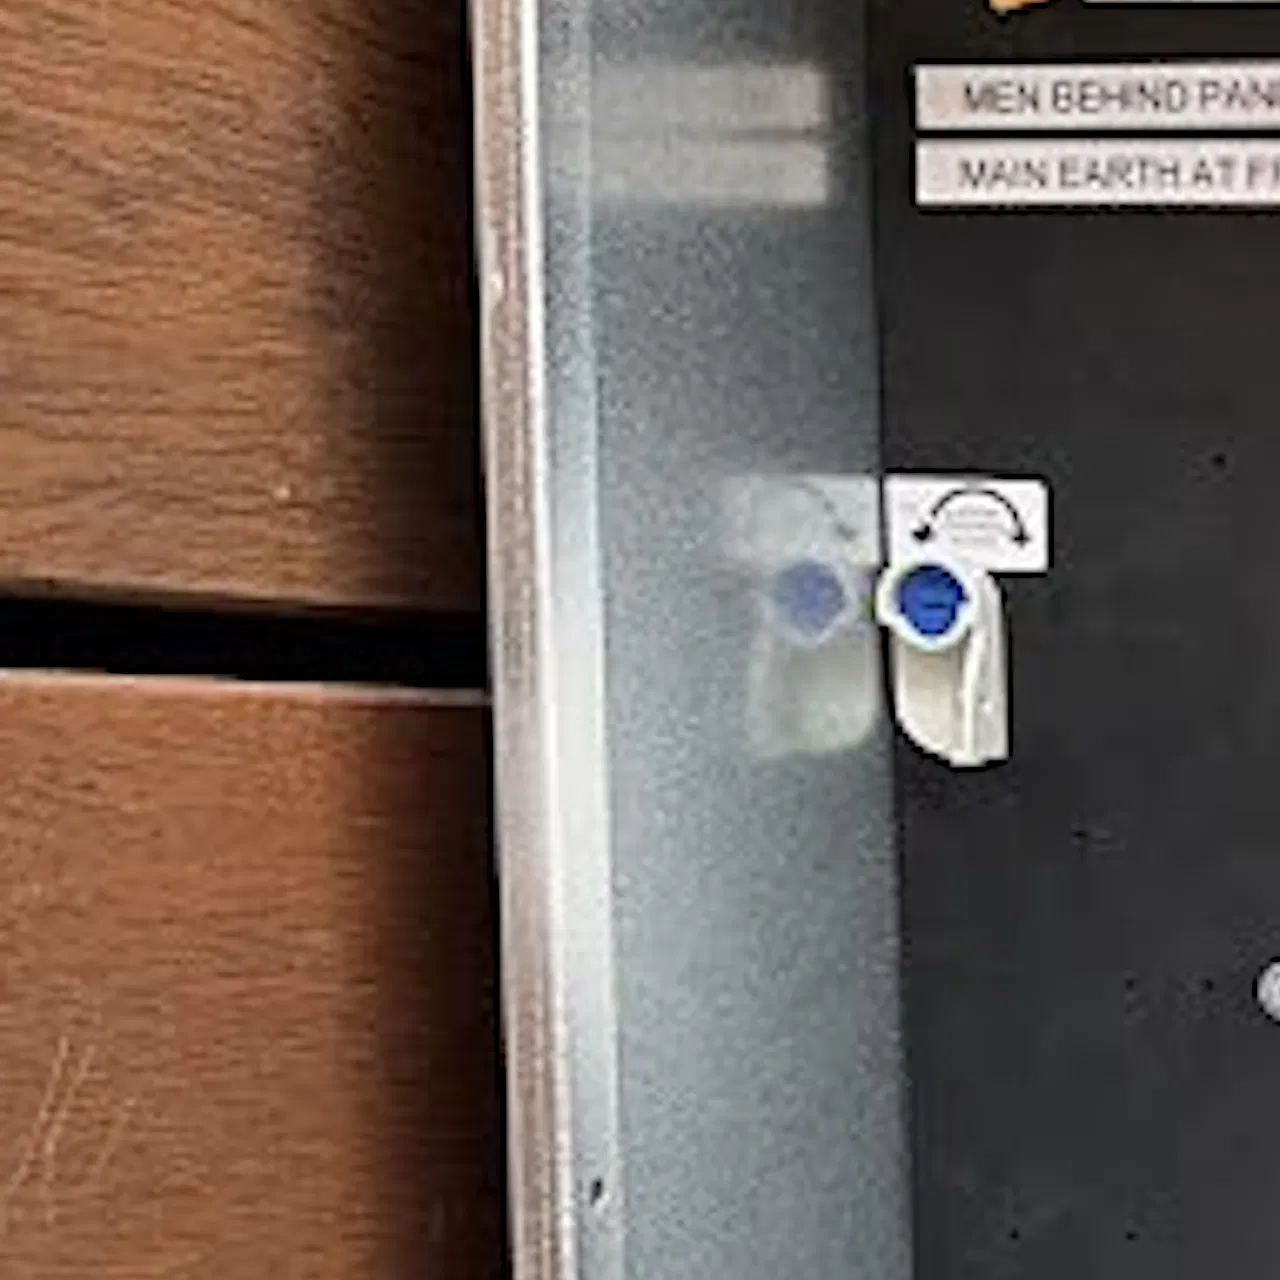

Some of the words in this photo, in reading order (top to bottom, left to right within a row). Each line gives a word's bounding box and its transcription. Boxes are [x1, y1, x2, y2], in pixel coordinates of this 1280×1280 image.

[1052, 79, 1188, 114] BEHIND
[958, 158, 1047, 190] MAIN
[1059, 157, 1180, 189] EARTH
[1192, 156, 1238, 188] AT
